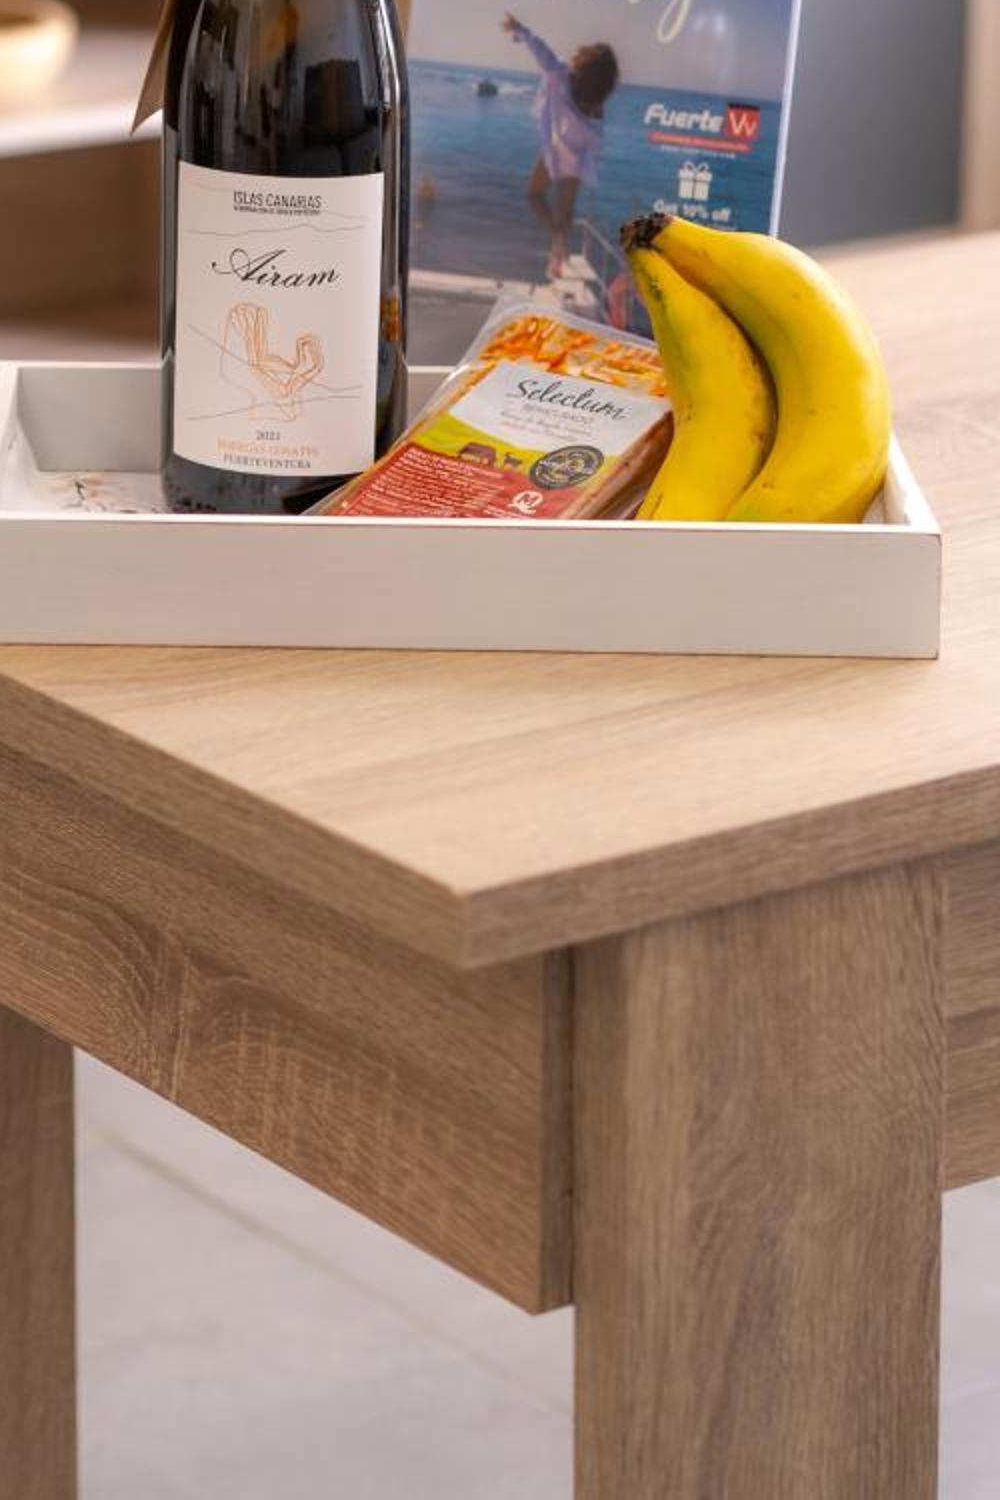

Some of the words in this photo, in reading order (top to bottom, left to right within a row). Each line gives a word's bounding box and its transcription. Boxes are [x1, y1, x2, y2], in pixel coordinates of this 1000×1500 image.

[643, 103, 724, 133] Fuerte
[232, 191, 263, 207] ISLAS
[266, 193, 322, 209] CANARIAS
[211, 248, 341, 288] Airam
[505, 378, 629, 421] Selectum
